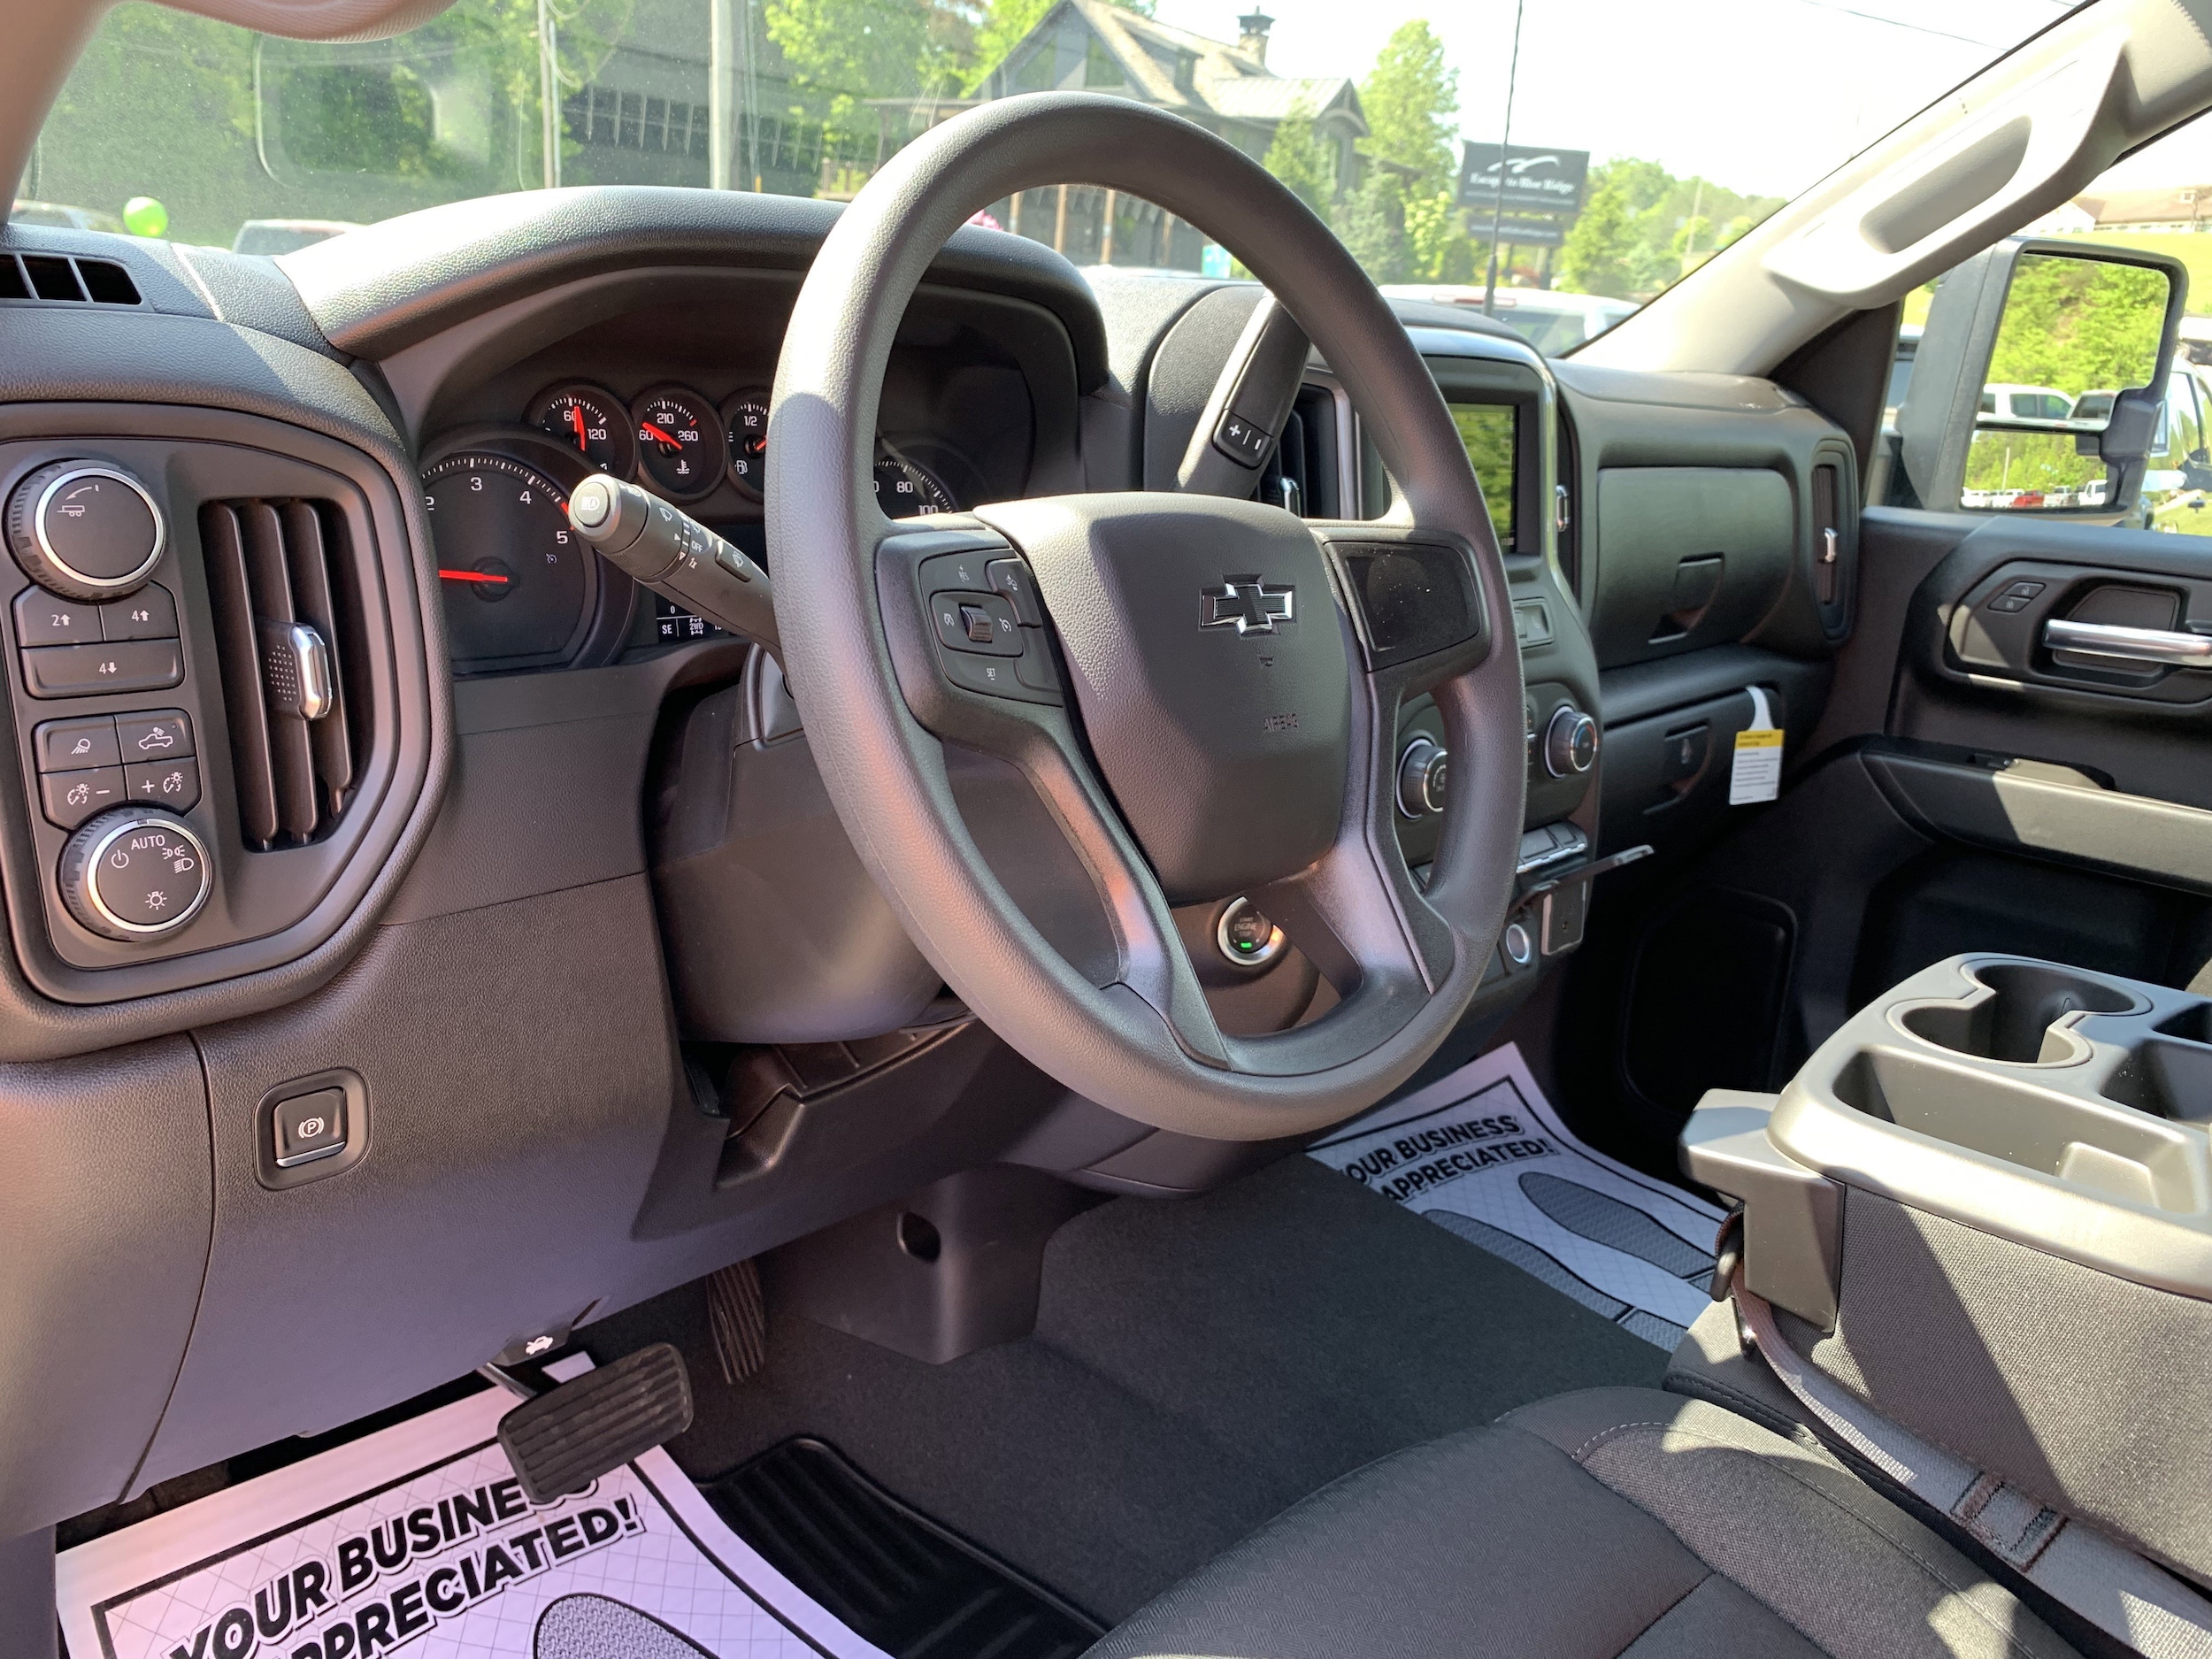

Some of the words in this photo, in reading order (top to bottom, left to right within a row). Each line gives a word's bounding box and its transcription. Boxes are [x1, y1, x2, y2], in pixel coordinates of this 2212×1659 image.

[657, 412, 674, 425] 210
[743, 415, 758, 427] 1/2
[587, 428, 607, 441] 120
[677, 430, 699, 442] 260
[470, 476, 483, 491] 3
[896, 480, 914, 493] 80
[518, 490, 532, 505] 4
[556, 530, 569, 544] 5
[691, 541, 703, 553] OFF
[670, 605, 676, 614] 0
[661, 624, 673, 635] SE
[131, 833, 166, 851] AUTO
[1345, 1147, 1398, 1184] OUR
[1394, 1114, 1521, 1161] BUSINESS
[1380, 1138, 1554, 1202] APPRECIATED!
[337, 1477, 593, 1594] BUSINE
